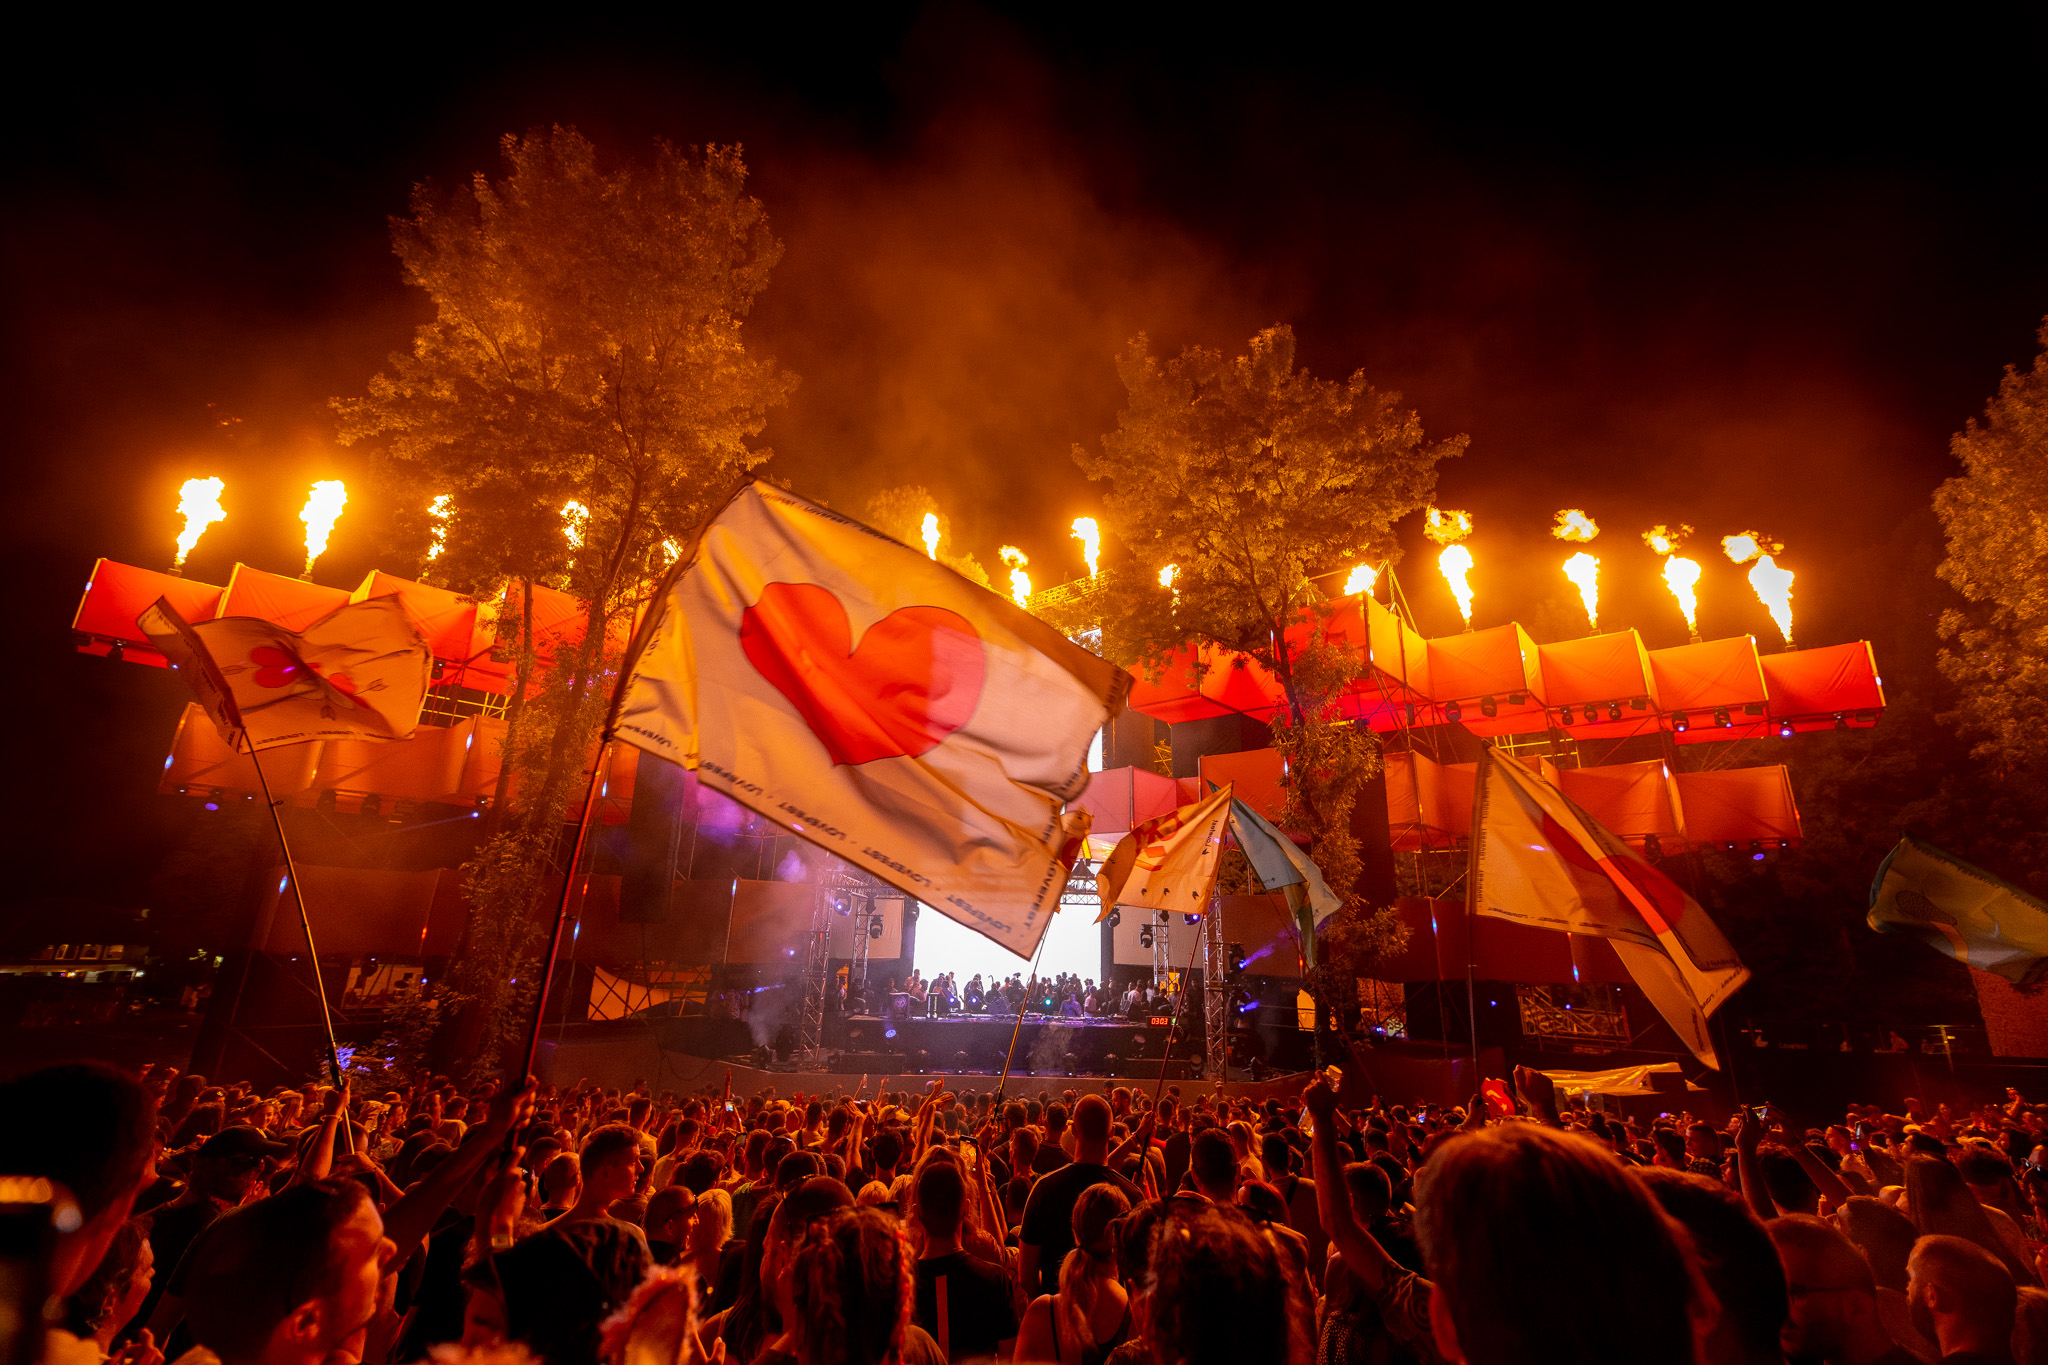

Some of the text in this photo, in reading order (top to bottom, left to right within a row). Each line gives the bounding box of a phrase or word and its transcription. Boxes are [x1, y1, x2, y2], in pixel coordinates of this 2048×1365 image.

[776, 801, 848, 841] LOVEFEST
[860, 846, 933, 888] LOVEFEST
[946, 894, 1013, 934] LOVEFEST
[1023, 860, 1058, 930] LOVEFEST
